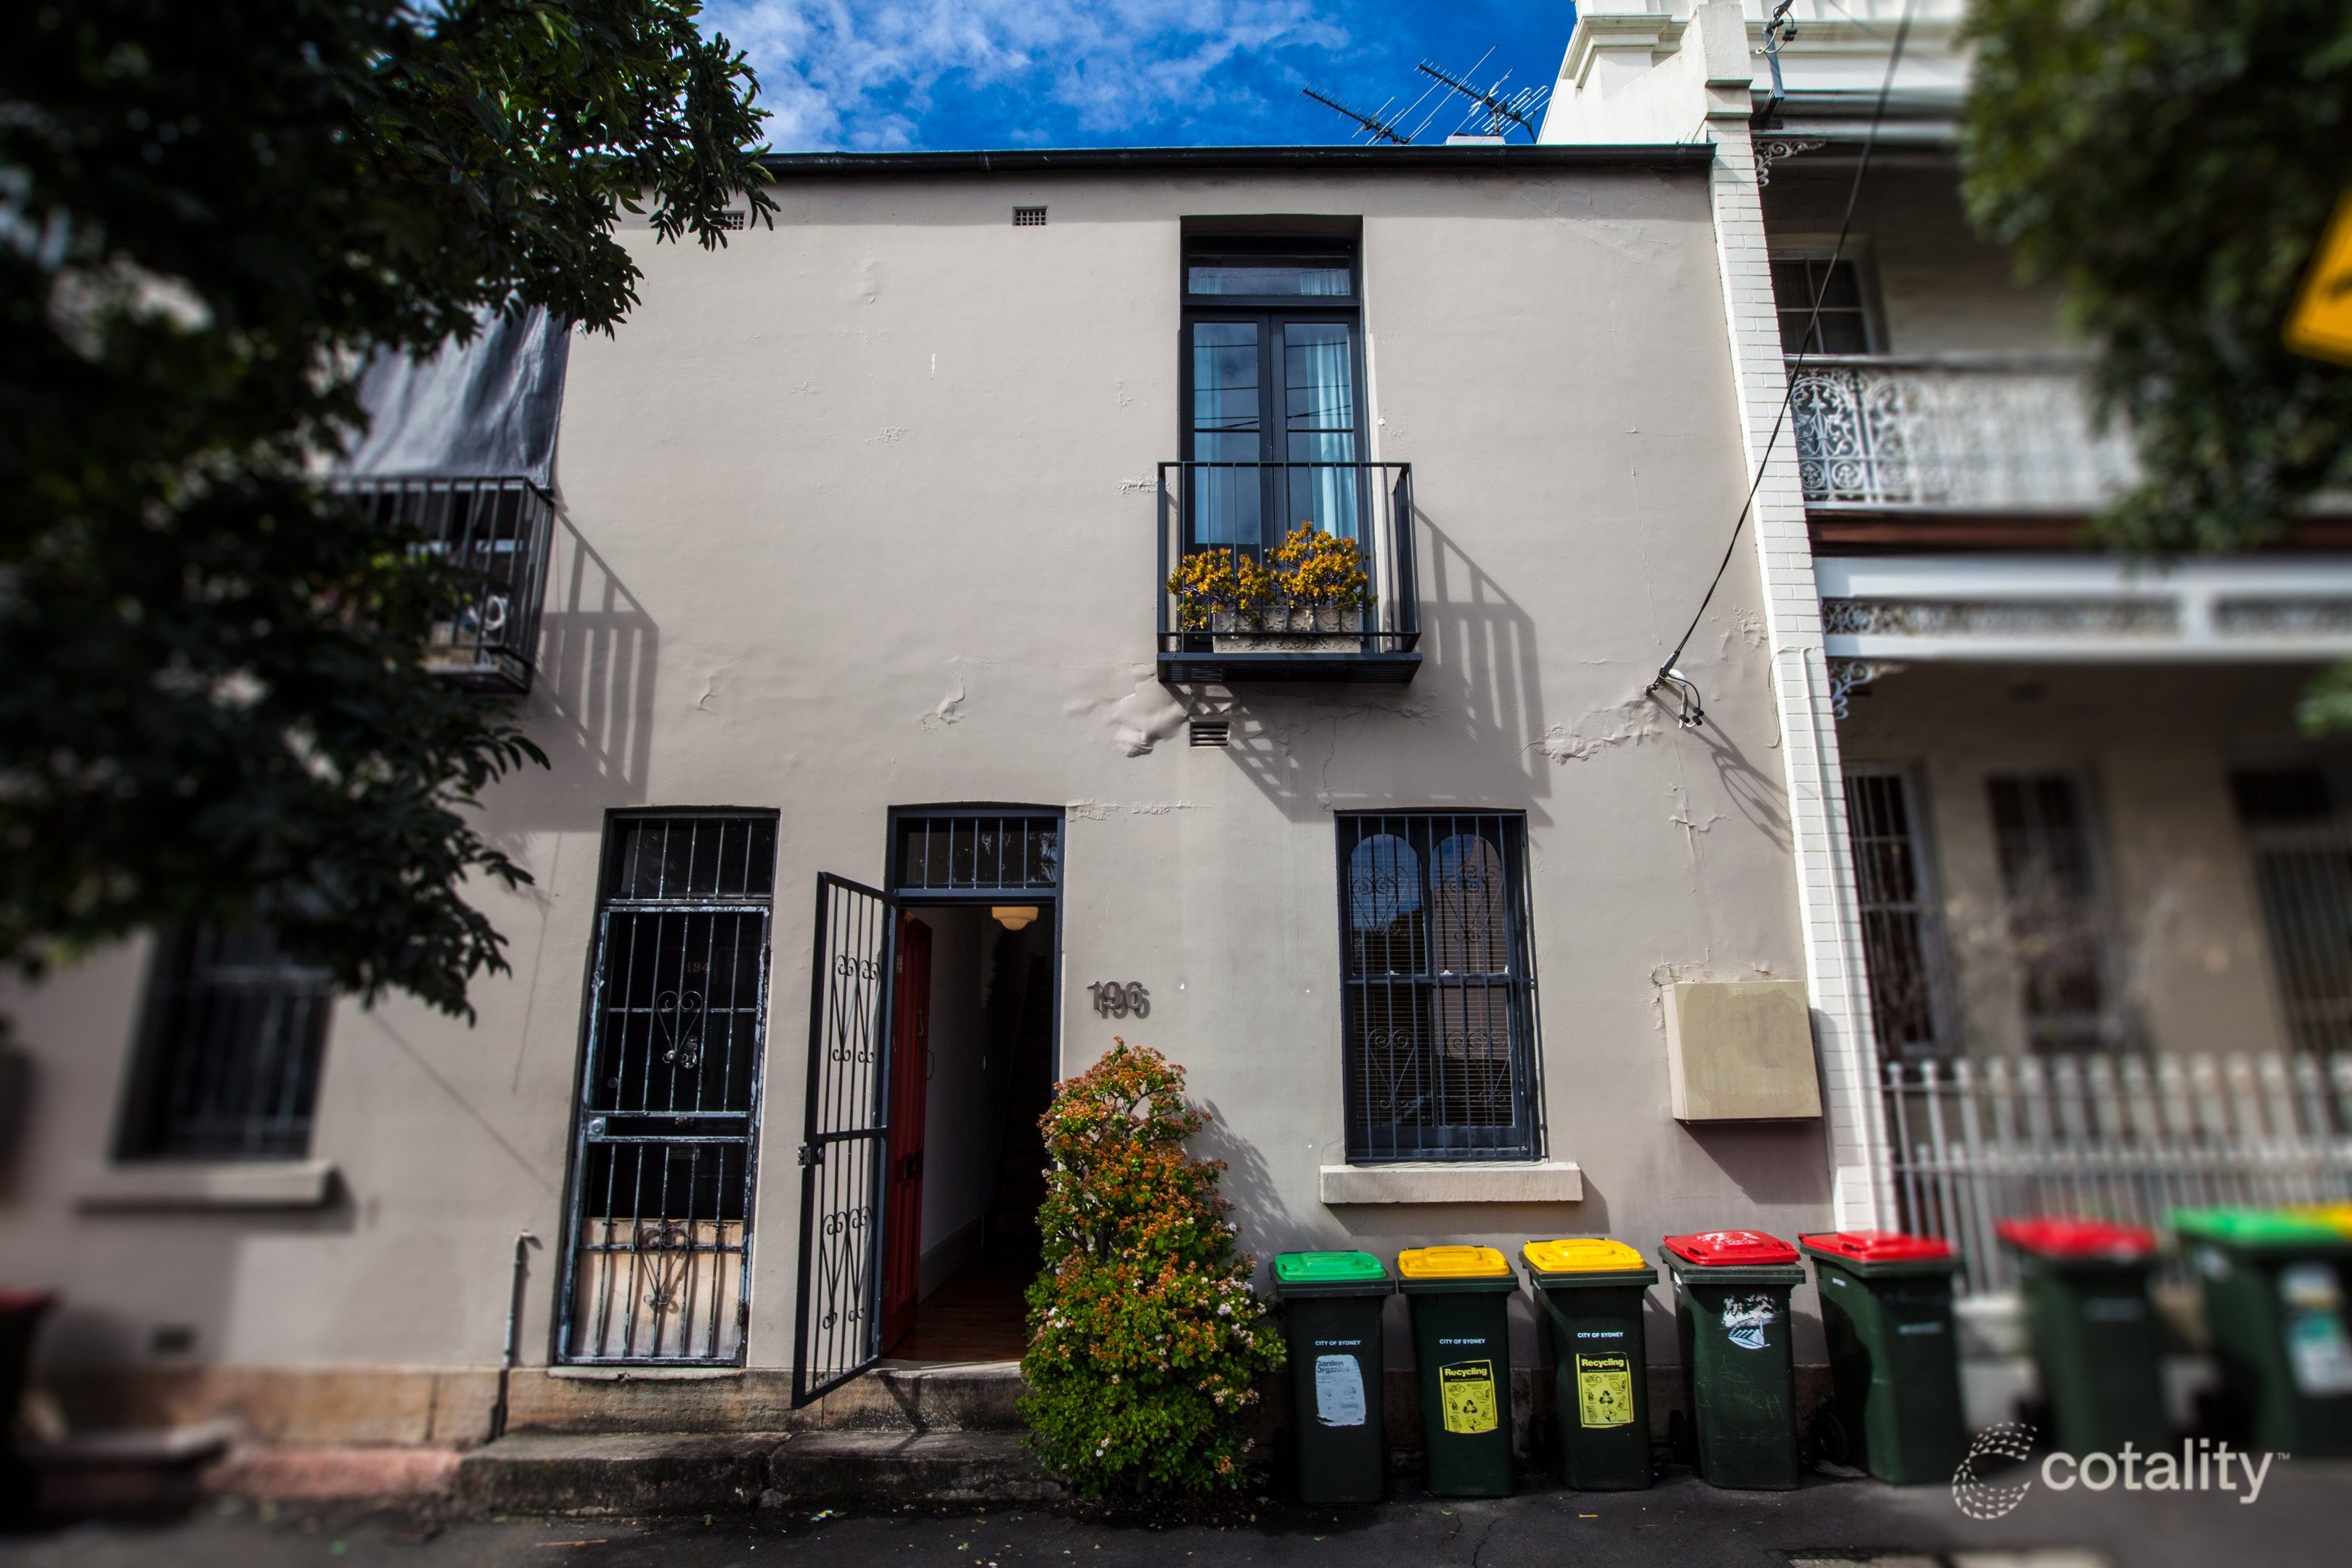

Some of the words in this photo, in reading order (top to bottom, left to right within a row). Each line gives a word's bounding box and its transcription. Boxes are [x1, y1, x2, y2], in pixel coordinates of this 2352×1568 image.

[1087, 981, 1143, 1010] 196
[1581, 1358, 1624, 1368] Recycling
[1445, 1368, 1487, 1377] Recycling
